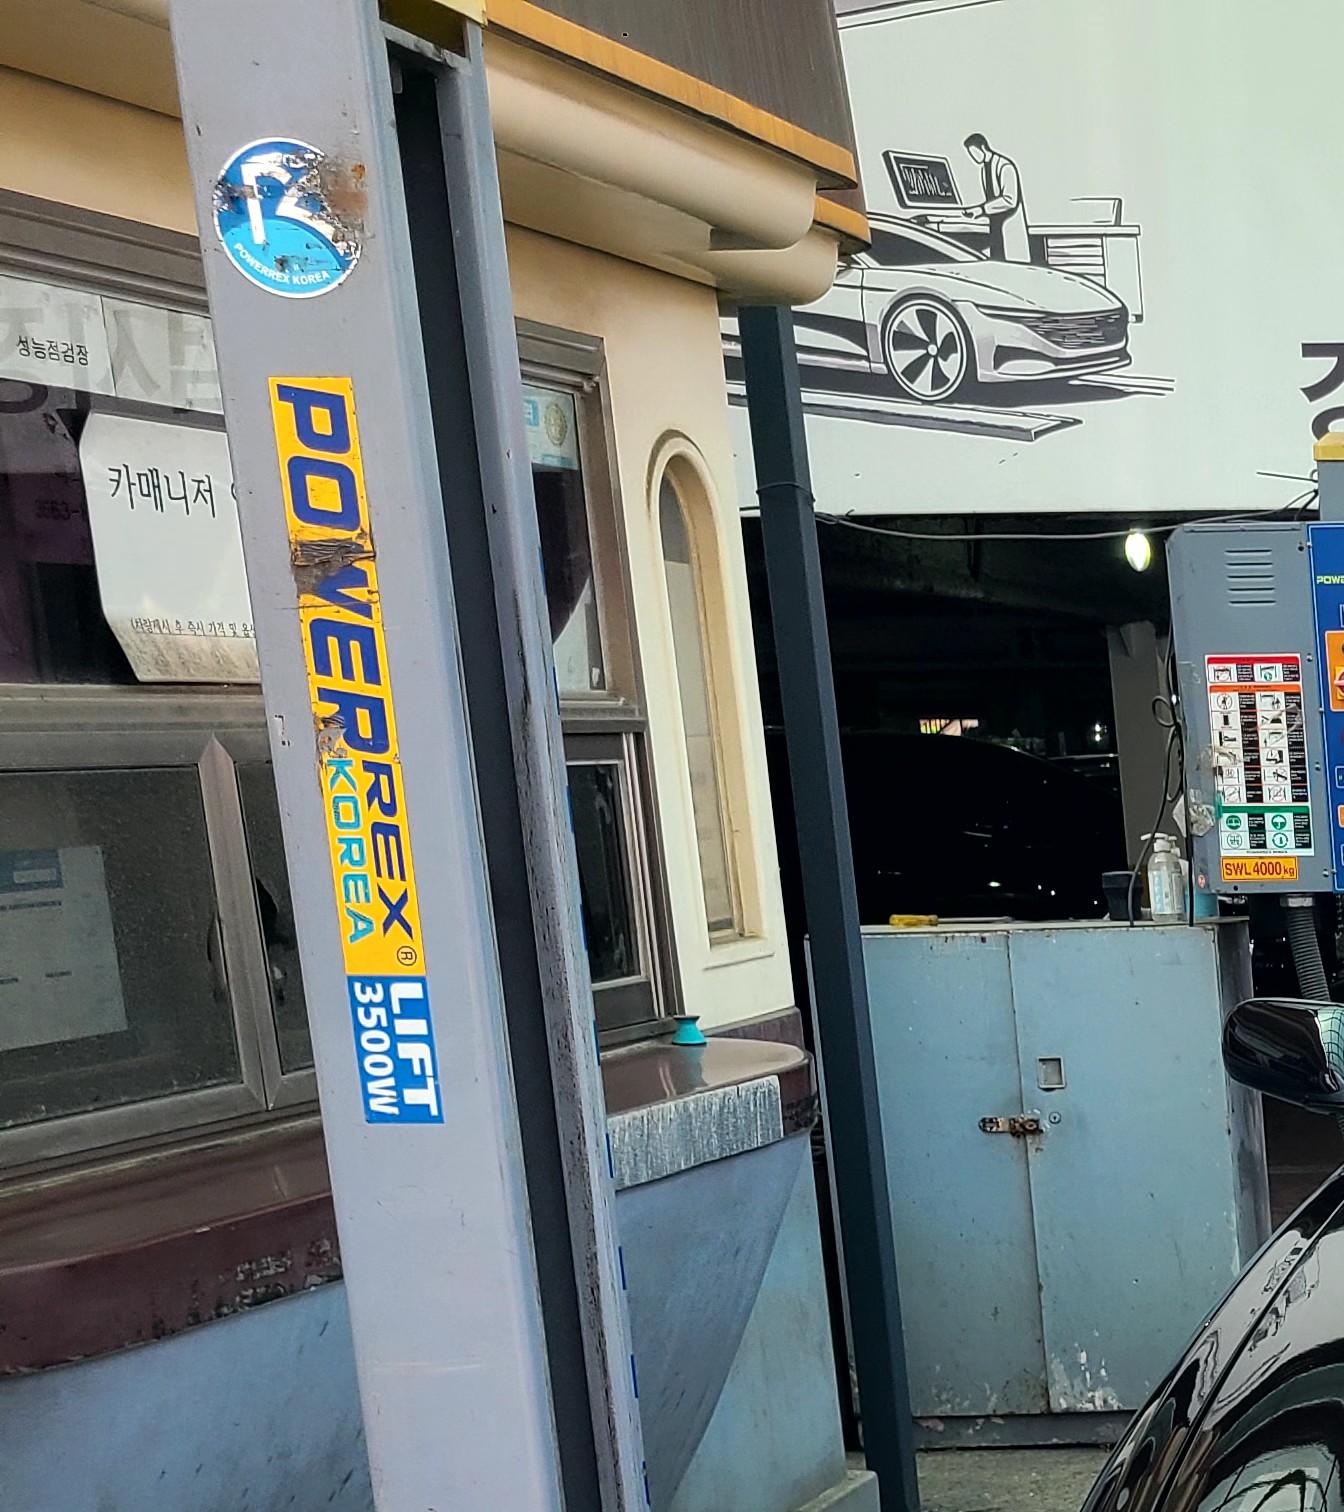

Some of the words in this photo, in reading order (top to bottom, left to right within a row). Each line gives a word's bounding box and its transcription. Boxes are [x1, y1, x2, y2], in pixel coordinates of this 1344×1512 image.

[234, 242, 290, 284] POWERREX
[292, 271, 330, 284] KOREA
[17, 335, 88, 365] 성능점검장
[107, 463, 216, 518] 카매니저
[327, 758, 376, 944] KOREA
[1224, 862, 1251, 876] SWL
[1253, 861, 1282, 876] 4000
[1283, 865, 1295, 877] kg
[354, 981, 400, 1116] 3500W
[389, 981, 439, 1117] LIFT
